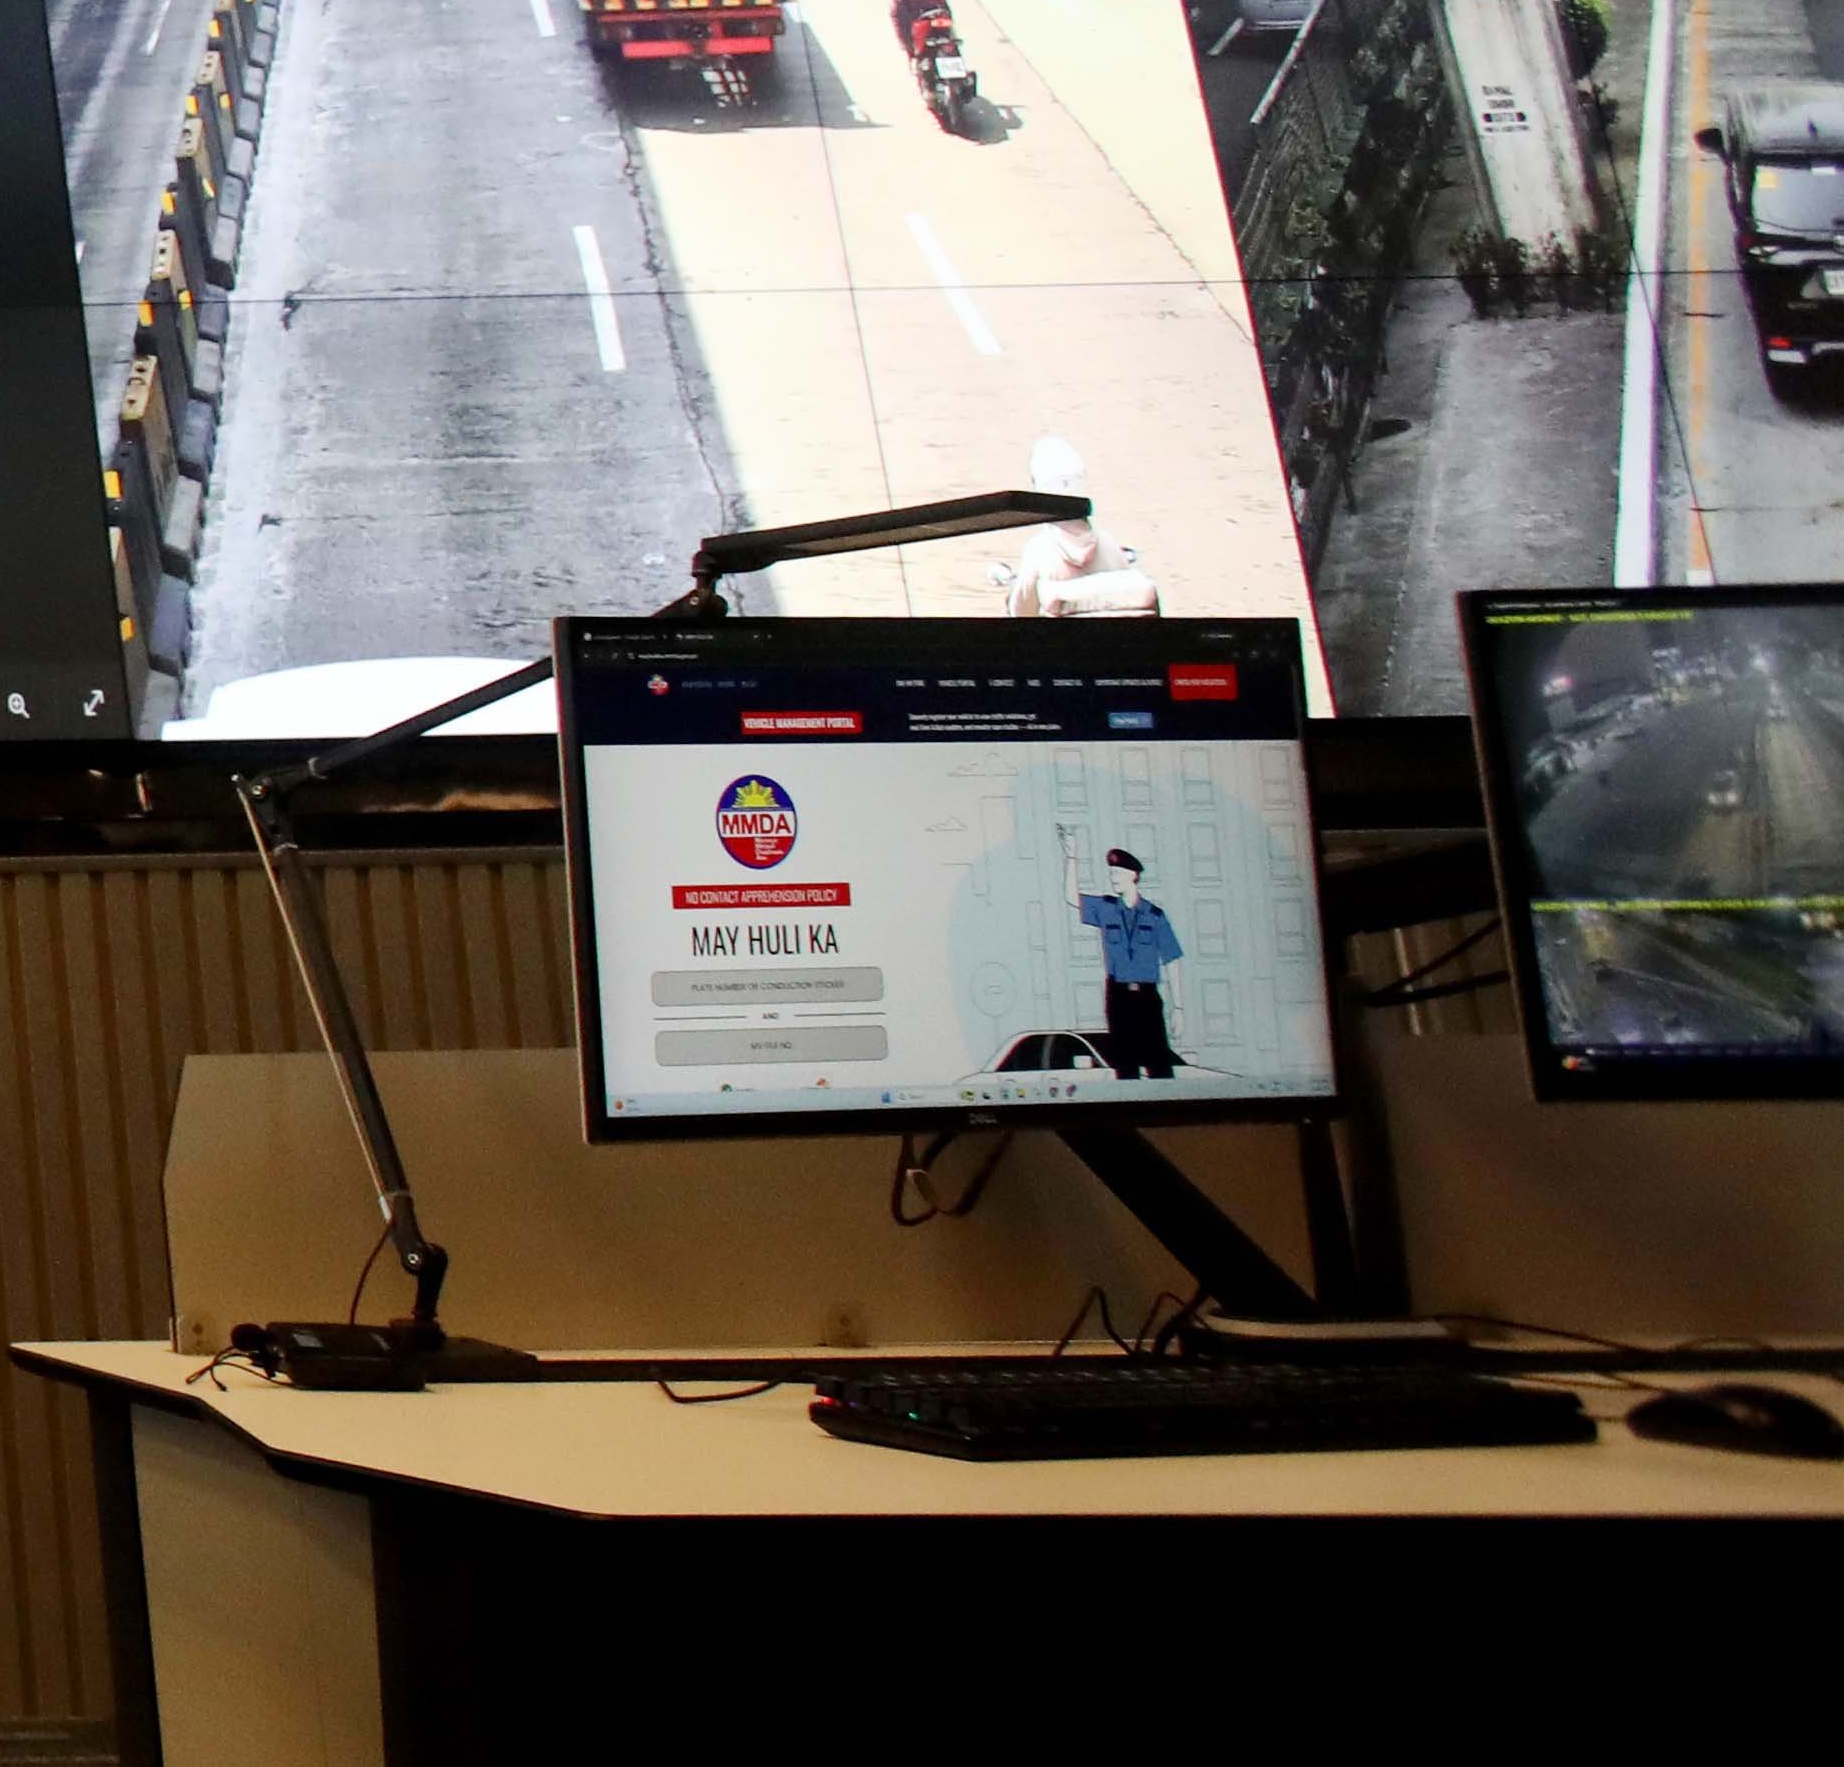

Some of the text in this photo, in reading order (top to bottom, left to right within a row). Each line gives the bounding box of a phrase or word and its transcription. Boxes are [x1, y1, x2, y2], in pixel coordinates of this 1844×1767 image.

[721, 813, 792, 834] MMDA
[685, 889, 837, 904] NO CONTACT APPREHENSION POLICY
[692, 924, 839, 956] MAY HULI KA
[762, 1012, 779, 1020] AND
